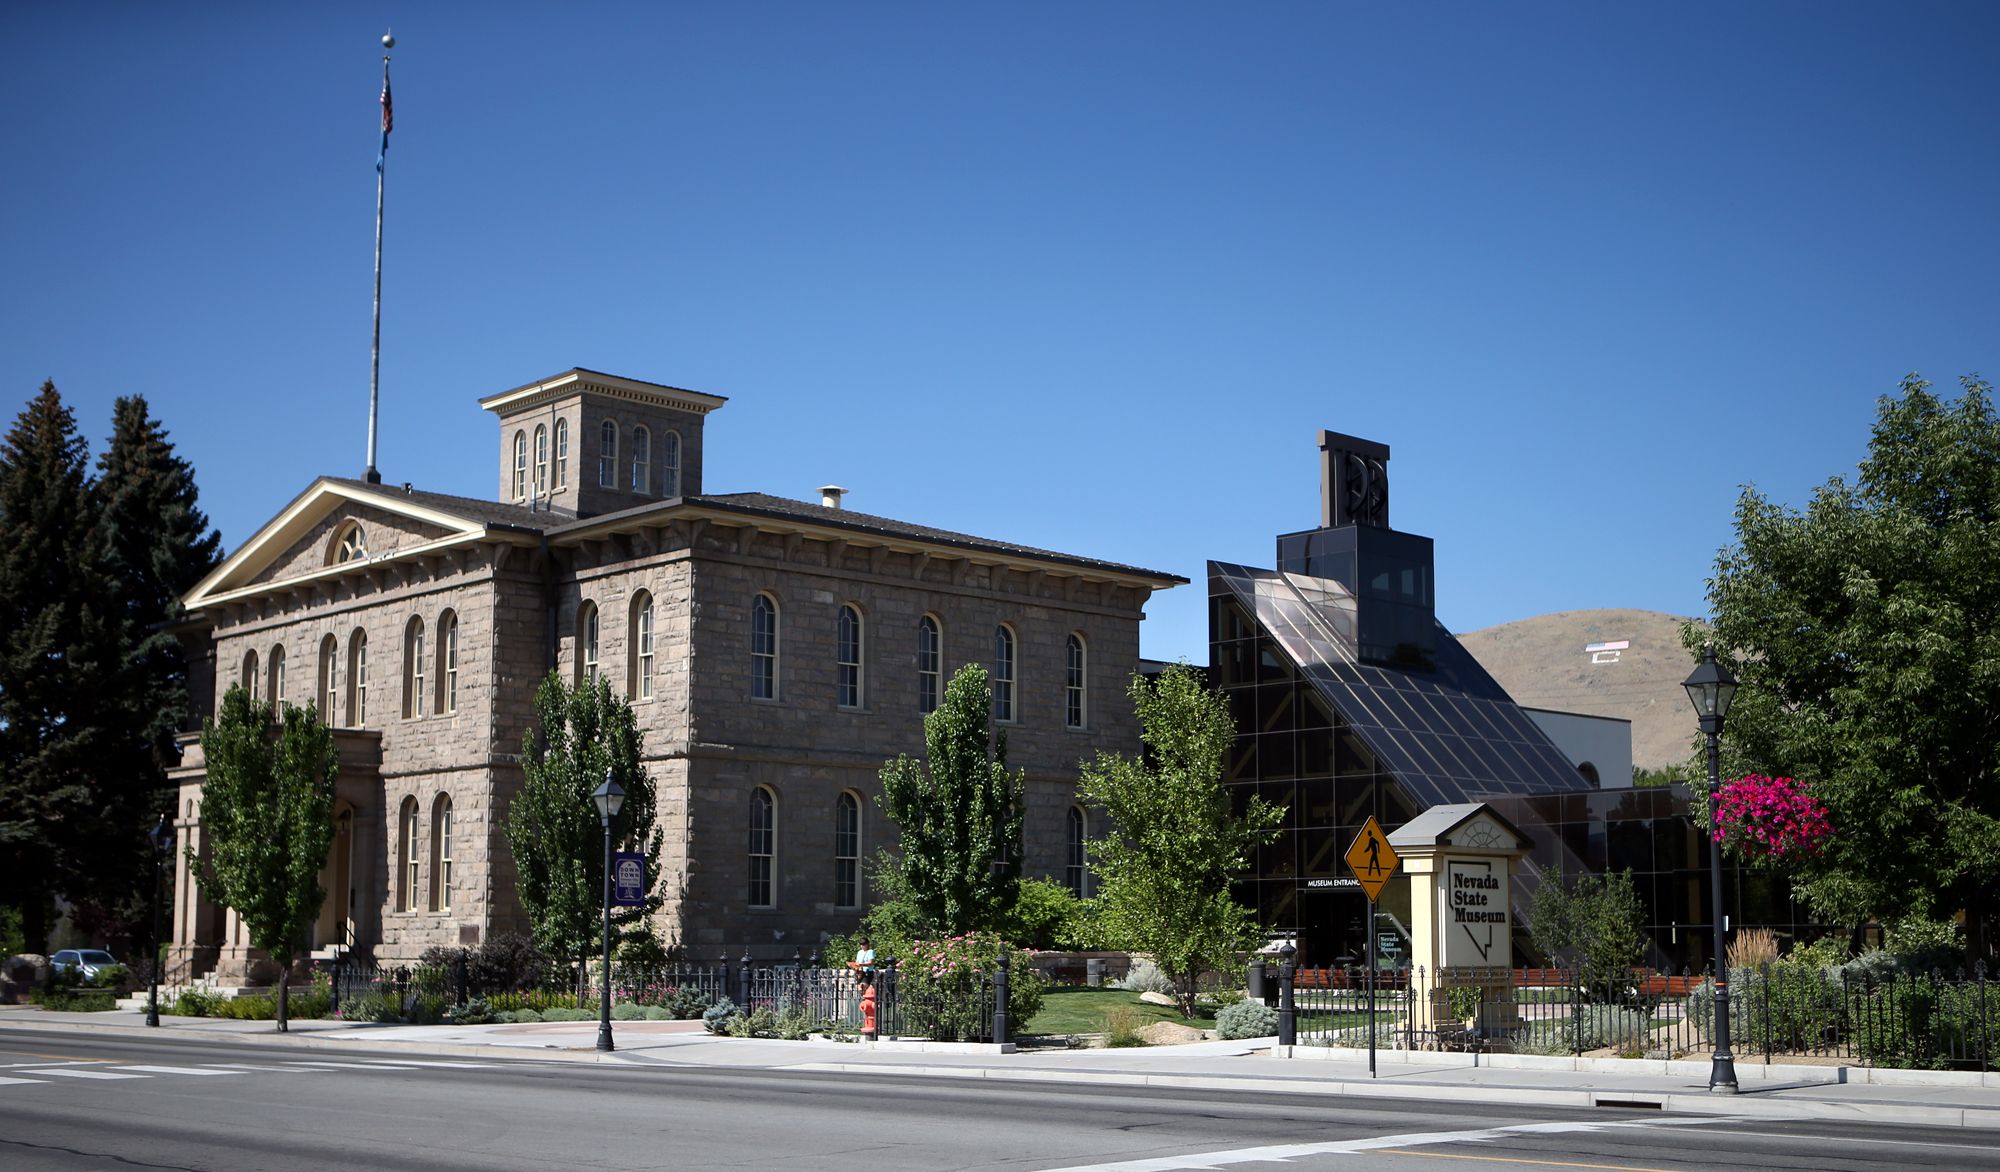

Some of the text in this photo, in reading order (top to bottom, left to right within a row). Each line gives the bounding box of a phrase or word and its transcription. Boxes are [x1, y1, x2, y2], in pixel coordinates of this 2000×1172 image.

[1333, 879, 1361, 887] ENTRANC
[1454, 873, 1499, 889] Nevada
[1454, 890, 1488, 906] State
[1455, 907, 1506, 923] Museum
